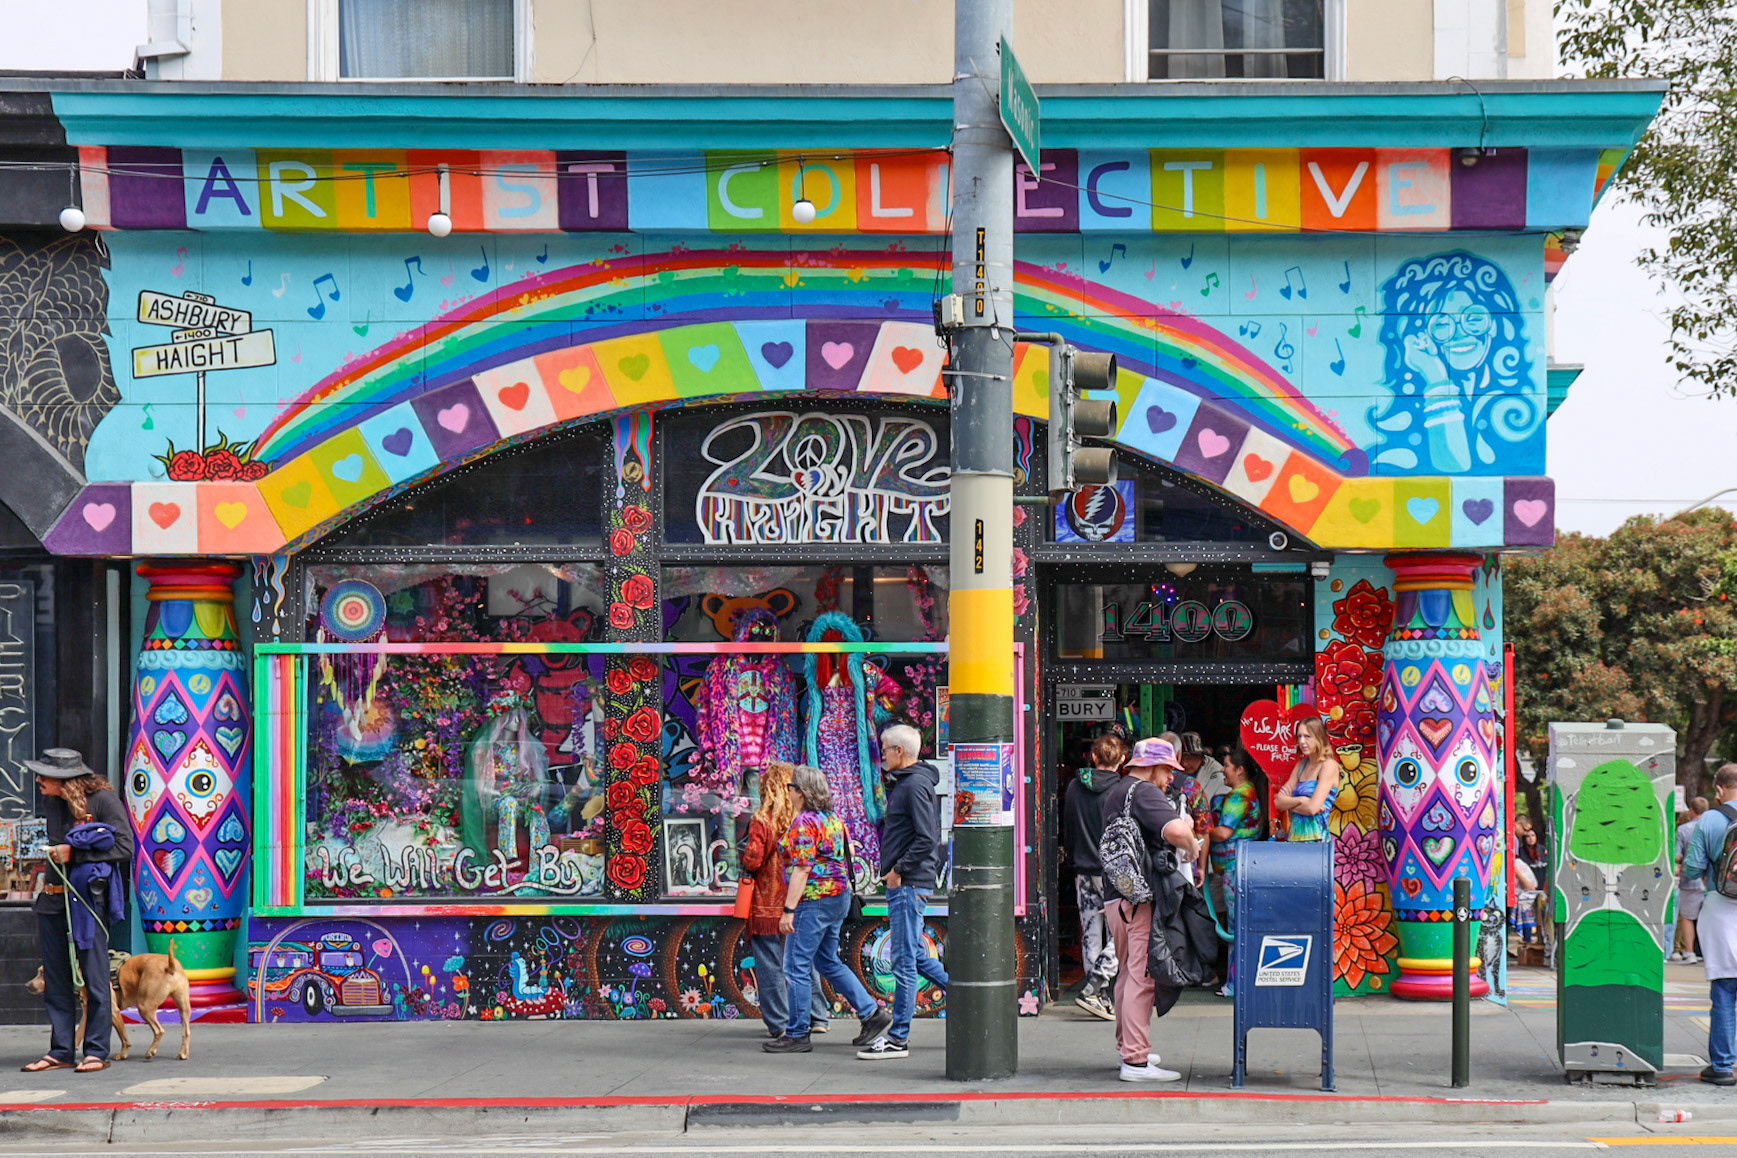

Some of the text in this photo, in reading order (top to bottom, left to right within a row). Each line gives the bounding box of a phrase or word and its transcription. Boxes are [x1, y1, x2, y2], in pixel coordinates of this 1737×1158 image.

[195, 155, 615, 219] ARTIST
[147, 299, 242, 331] ASHBURY
[184, 329, 212, 340] 1400
[156, 337, 244, 370] HAIGHT
[696, 492, 951, 545] HAIGHT
[975, 521, 983, 569] 142
[1096, 600, 1253, 643] 1400
[1061, 688, 1077, 698] 710
[317, 843, 583, 894] We Will Get By
[676, 838, 739, 889] We
